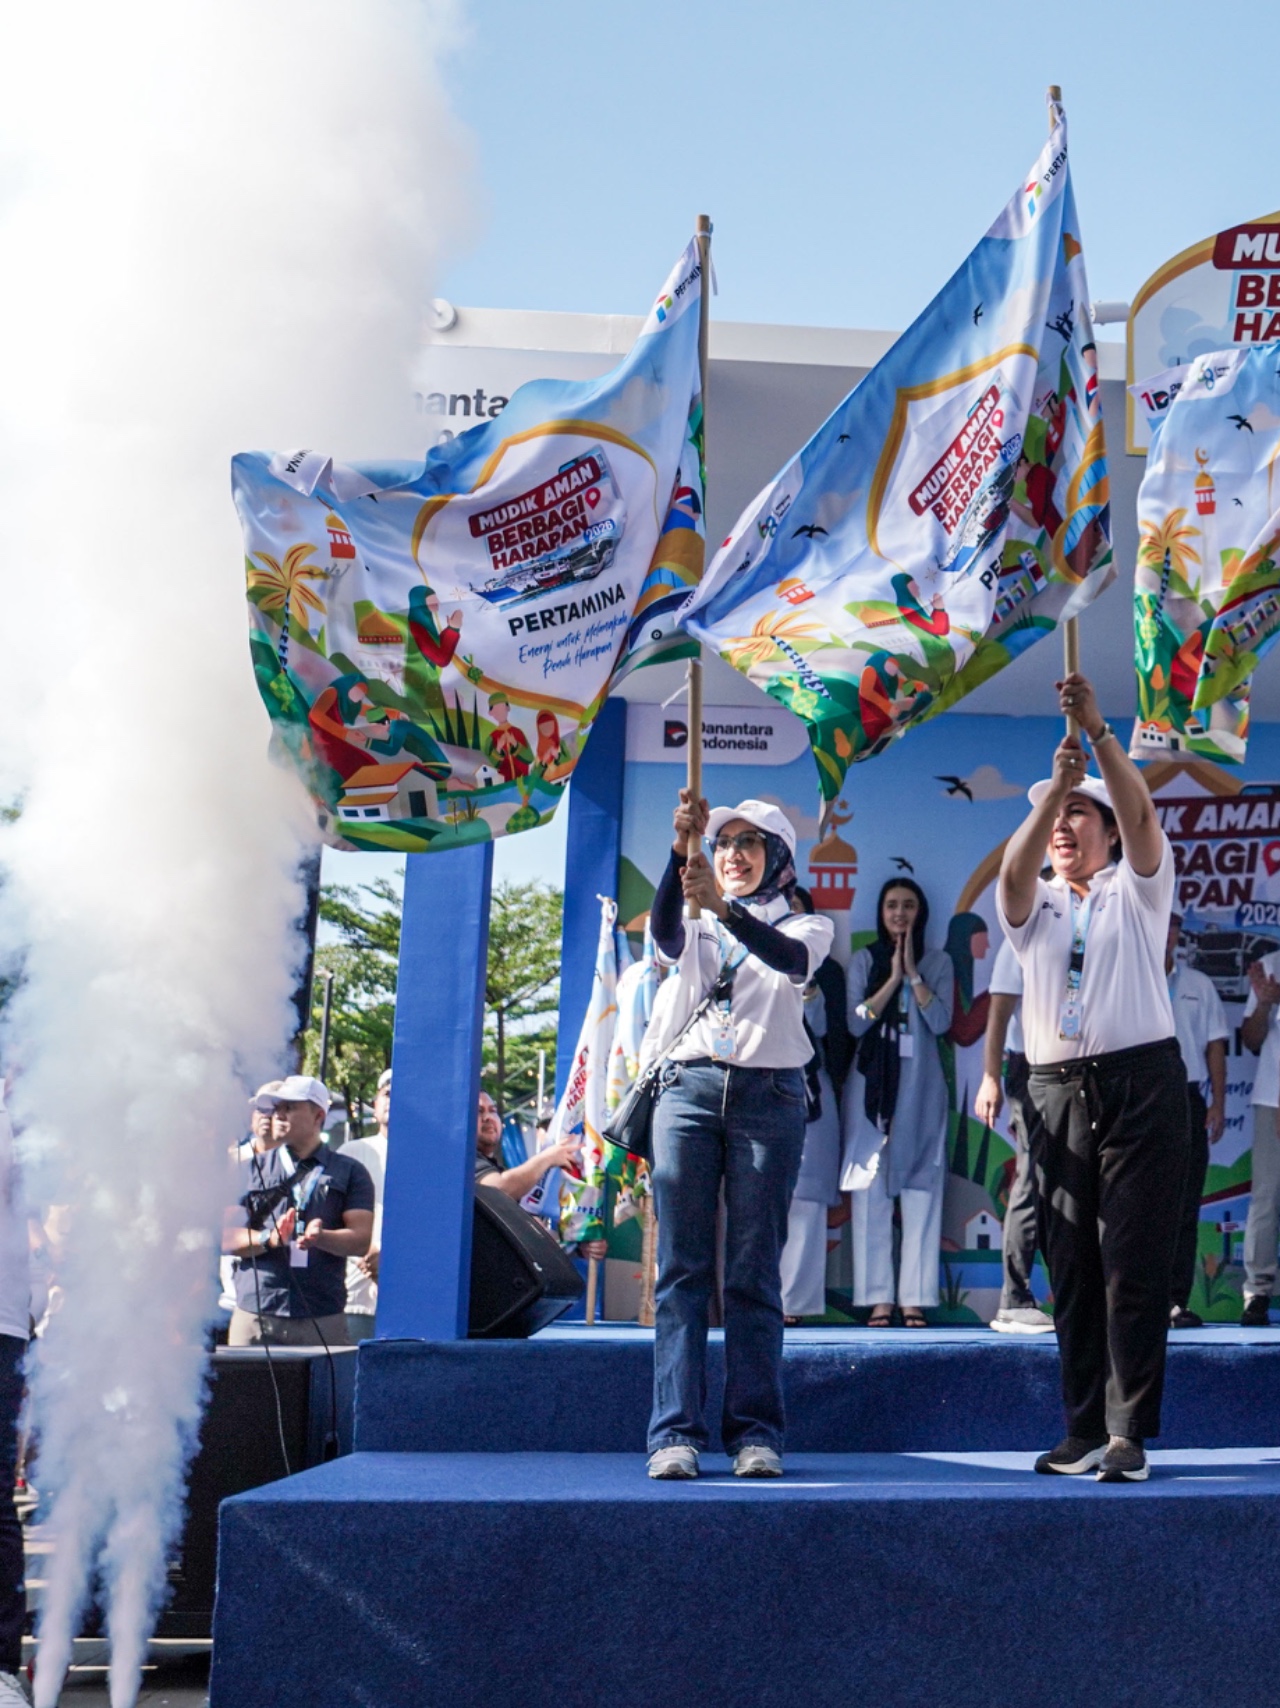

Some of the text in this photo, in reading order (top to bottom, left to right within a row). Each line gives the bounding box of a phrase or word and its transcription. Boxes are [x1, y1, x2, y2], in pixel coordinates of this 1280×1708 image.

[915, 393, 995, 508] MUDIK AMAN
[931, 424, 995, 522] BERBAGI
[478, 463, 594, 531] MUDIK AMAN
[943, 437, 1002, 536] HARAPAN
[487, 494, 585, 554] BERBAGI
[492, 514, 589, 570] HARAPAN
[585, 521, 613, 541] 2026
[508, 583, 626, 636] PERTAMINA
[518, 638, 553, 663] Energi
[556, 630, 581, 648] untuk
[702, 737, 768, 751] ndonesia
[1172, 841, 1260, 876] BAGI
